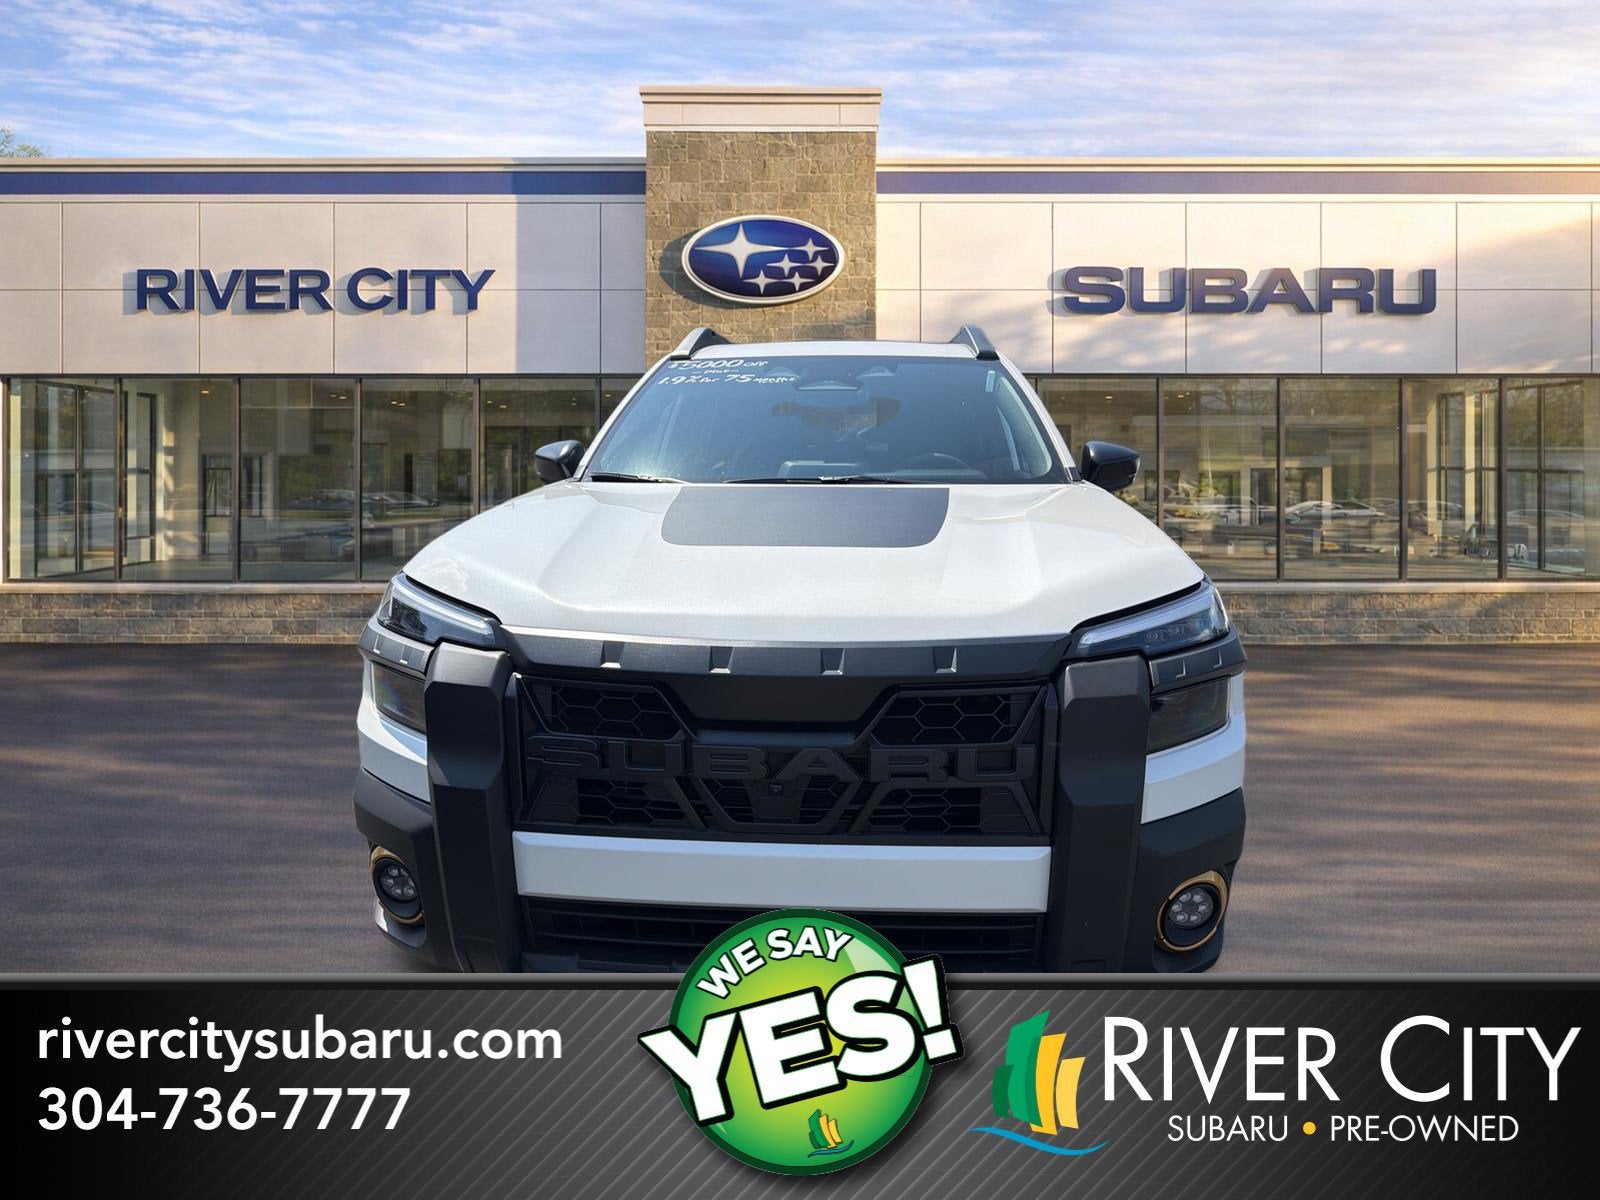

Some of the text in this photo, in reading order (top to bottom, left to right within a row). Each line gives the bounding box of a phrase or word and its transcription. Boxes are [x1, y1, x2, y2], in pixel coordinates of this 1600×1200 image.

[136, 267, 495, 310] RIVER CITY
[1063, 266, 1437, 315] SUBARU
[724, 374, 756, 383] 75
[525, 735, 1035, 782] SUBARU
